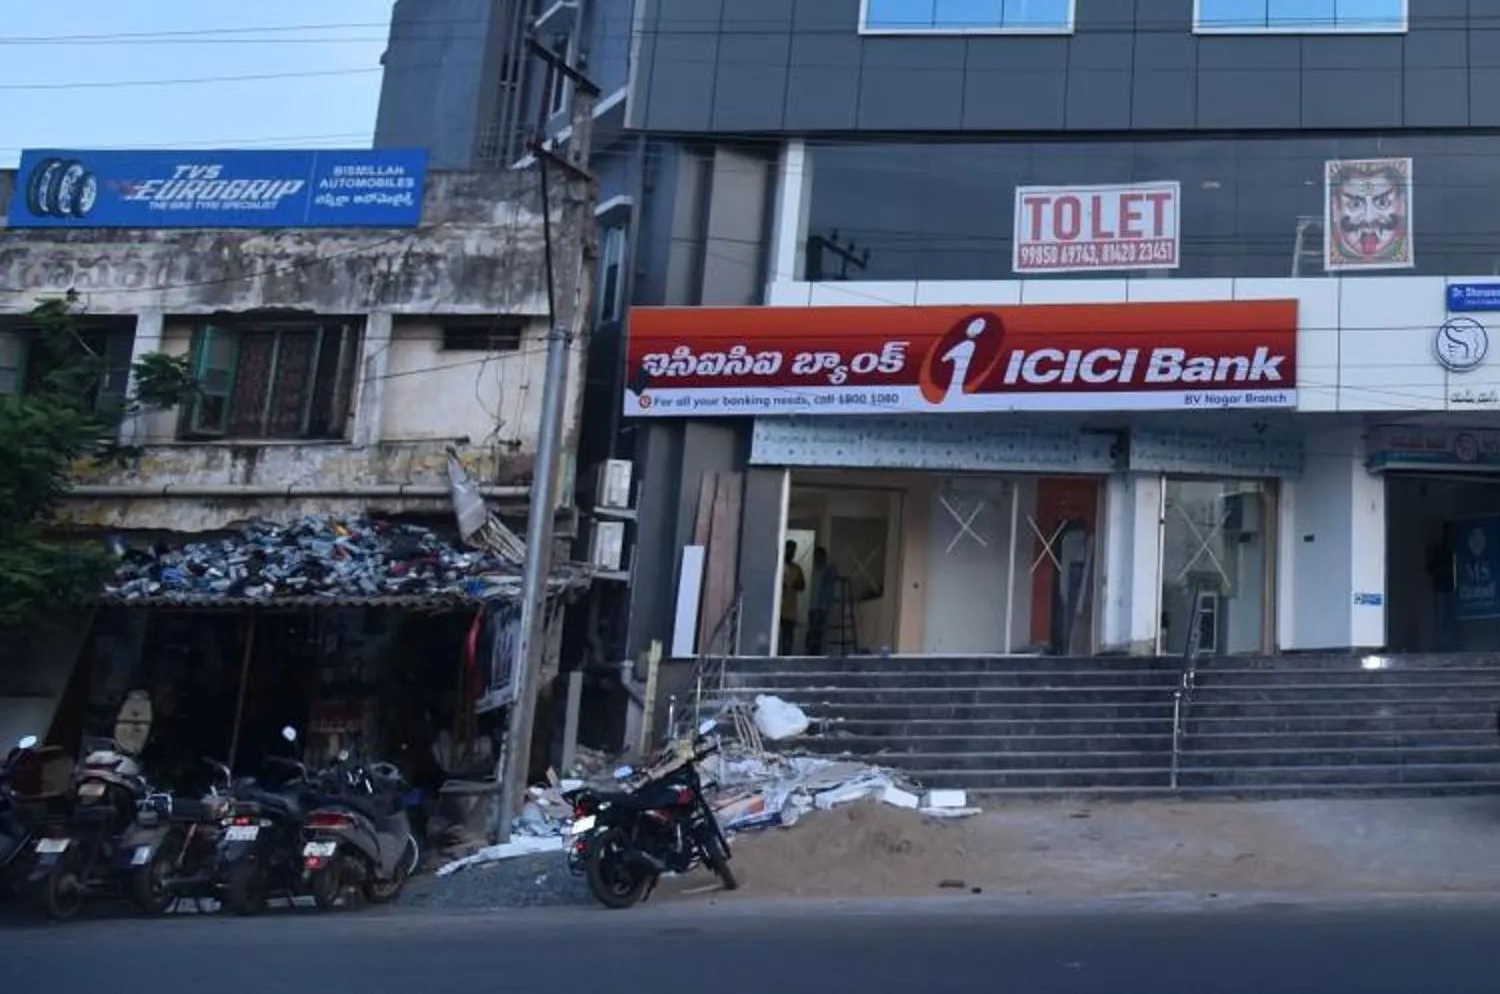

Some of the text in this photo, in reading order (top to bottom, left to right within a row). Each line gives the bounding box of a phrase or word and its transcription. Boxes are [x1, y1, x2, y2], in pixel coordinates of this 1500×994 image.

[171, 164, 224, 179] TVS
[128, 179, 304, 200] EUROGRIP
[319, 177, 416, 189] AUTOMOBILES
[1023, 193, 1172, 241] TO LET
[791, 340, 909, 385] బ్యాంక్
[1003, 346, 1287, 384] ICICI Bank
[694, 397, 721, 408] your
[722, 395, 771, 408] banking
